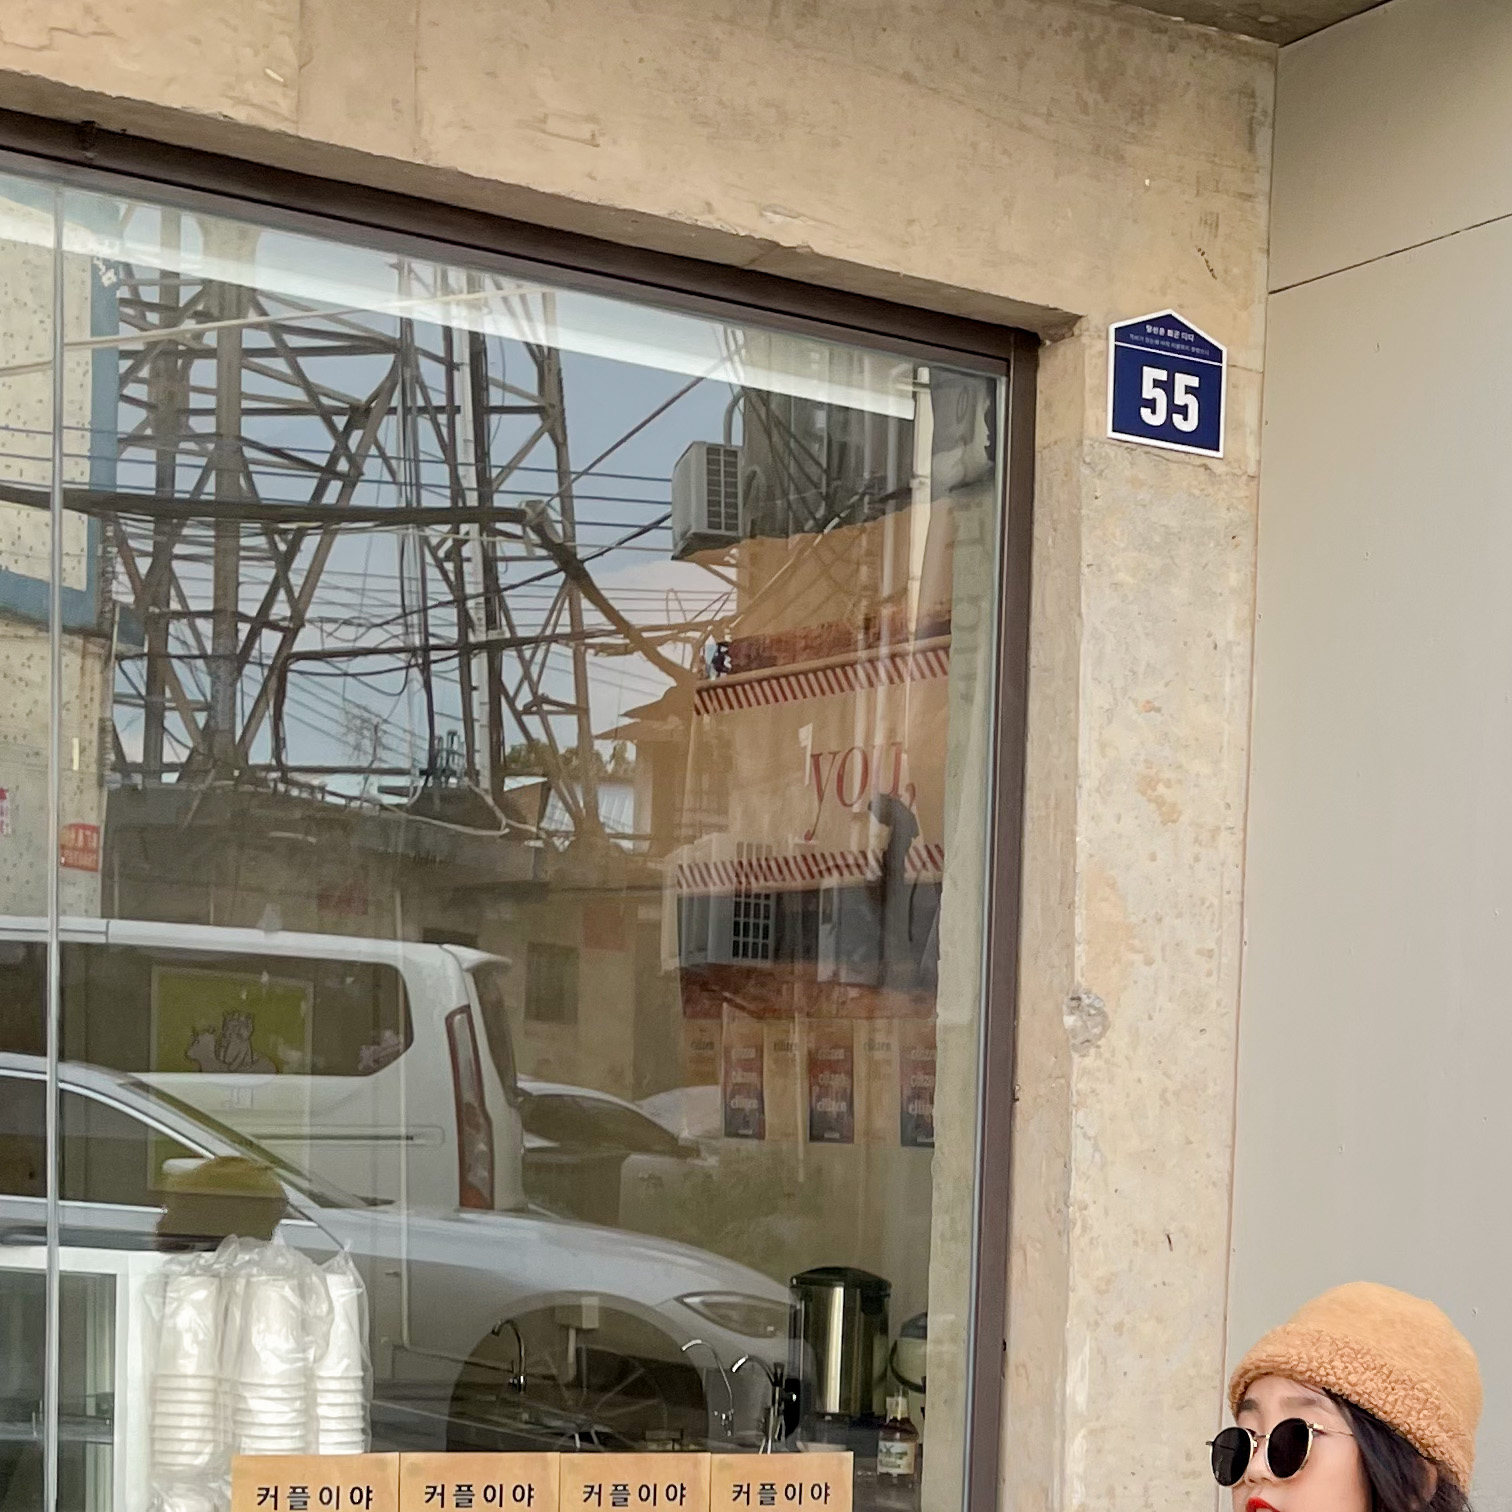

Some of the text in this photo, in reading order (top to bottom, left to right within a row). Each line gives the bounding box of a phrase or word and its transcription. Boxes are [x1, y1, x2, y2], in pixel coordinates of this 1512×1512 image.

[1140, 365, 1200, 433] 55
[256, 1485, 373, 1511] 커플이야
[424, 1483, 535, 1509] 커플이야
[583, 1482, 687, 1507] 커플이야
[732, 1482, 831, 1506] 커플이야
